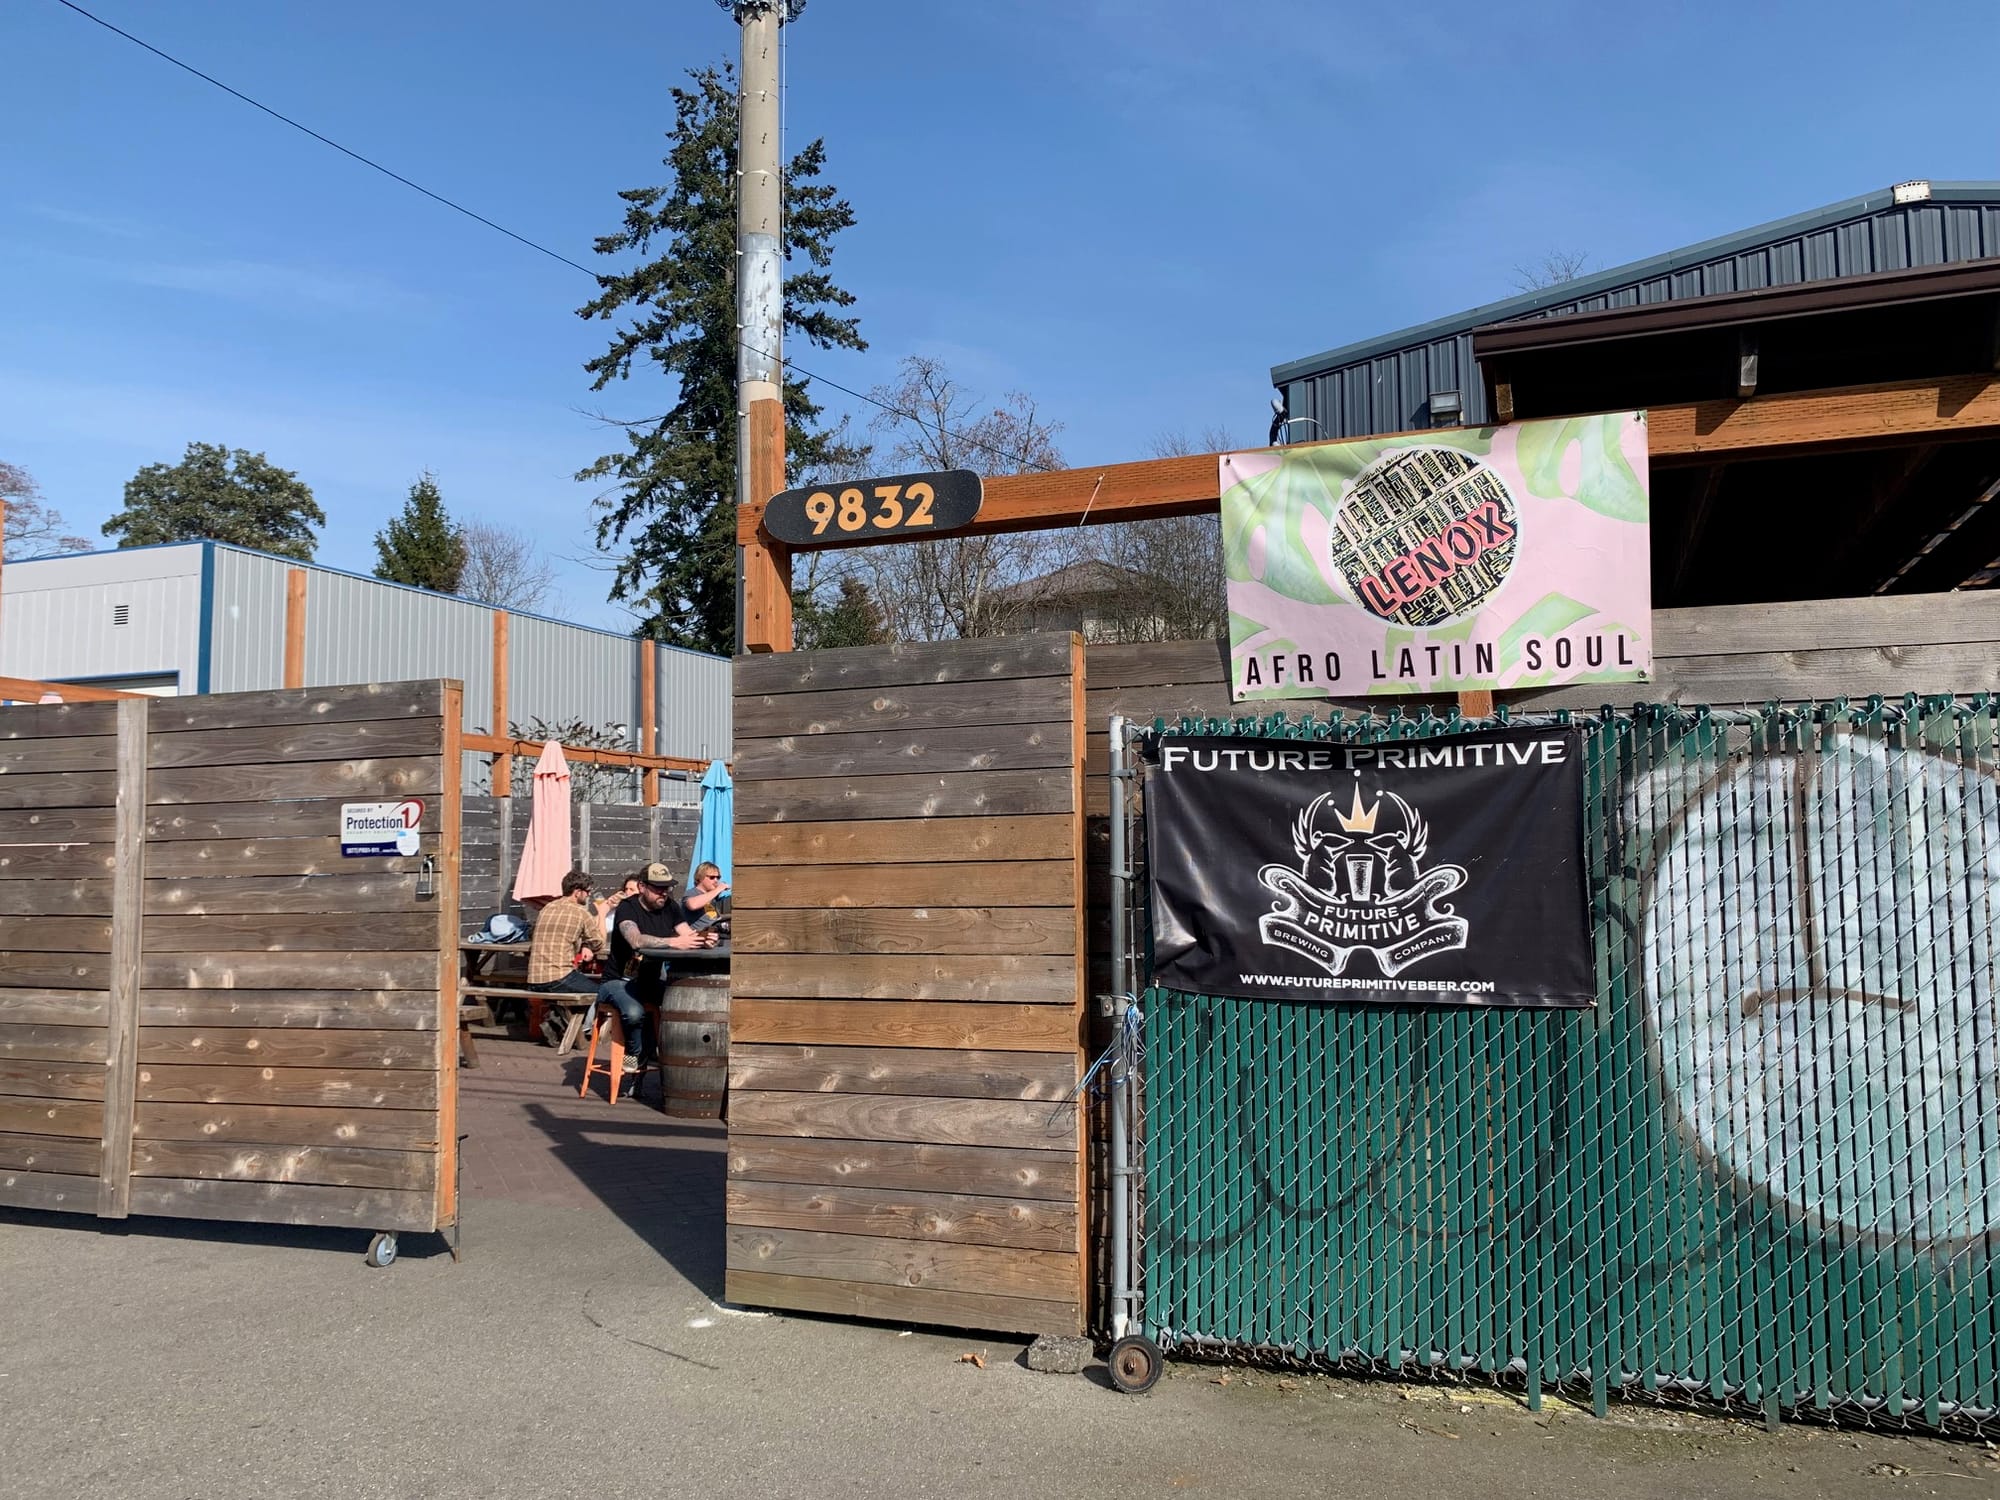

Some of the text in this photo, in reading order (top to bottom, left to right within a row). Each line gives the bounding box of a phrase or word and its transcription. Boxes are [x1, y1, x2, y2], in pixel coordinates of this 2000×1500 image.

[805, 482, 935, 535] 9832
[1362, 503, 1513, 615] LENOX
[1246, 634, 1633, 685] AFRO LATIN SOUL
[1163, 740, 1567, 772] FUTURE PRIMITIVE
[346, 816, 403, 830] Protection
[1304, 912, 1421, 940] PRIMITIVE
[1324, 906, 1399, 920] FUTURE
[1274, 929, 1454, 960] BREWING COMPANY
[1239, 974, 1495, 992] WWW.FUTUREPRIMITIVEBEER.COM
